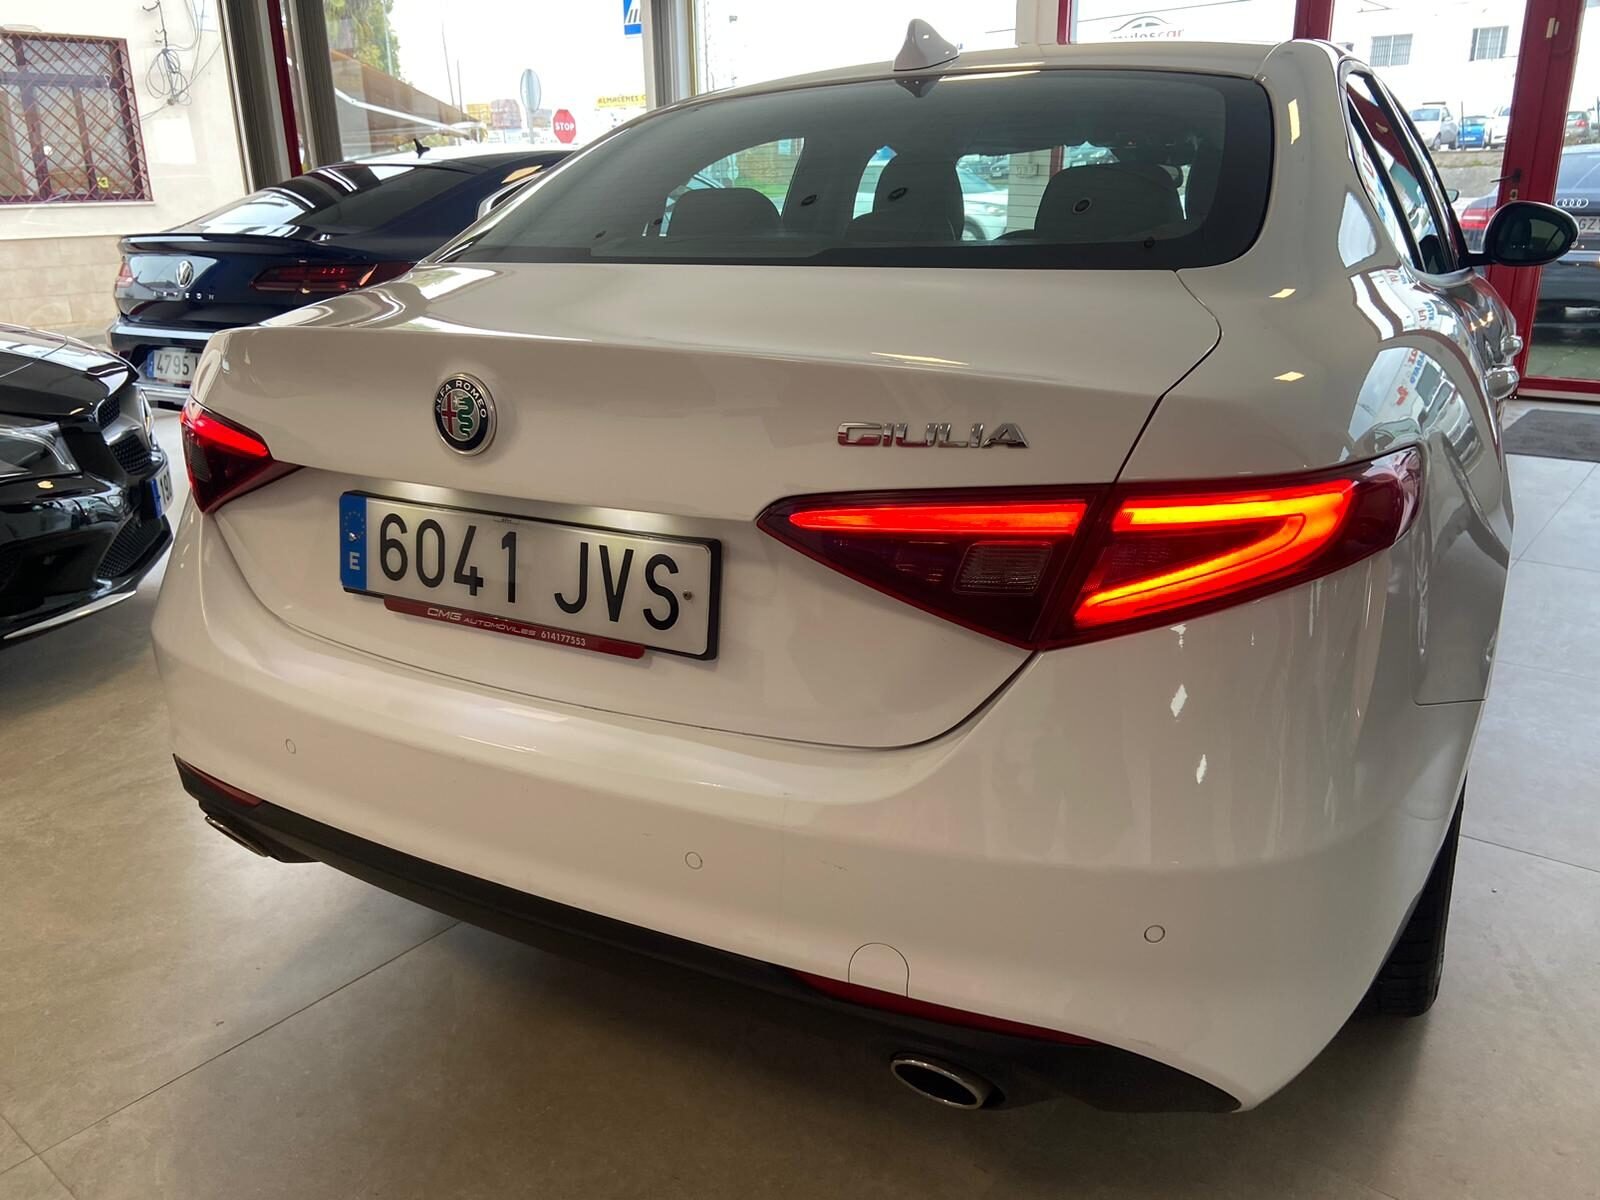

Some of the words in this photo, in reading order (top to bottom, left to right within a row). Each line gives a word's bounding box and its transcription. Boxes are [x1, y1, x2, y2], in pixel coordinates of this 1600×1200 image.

[554, 122, 575, 131] STOP
[1578, 217, 1600, 230] GZ
[157, 353, 190, 376] 4795
[436, 383, 452, 413] ALFA
[455, 380, 487, 418] ROMEO
[838, 422, 1029, 448] GIULIA
[349, 551, 361, 571] E
[379, 512, 519, 604] 6041
[553, 541, 680, 631] JVS
[427, 607, 462, 621] CMG
[540, 630, 587, 647] 614177553
